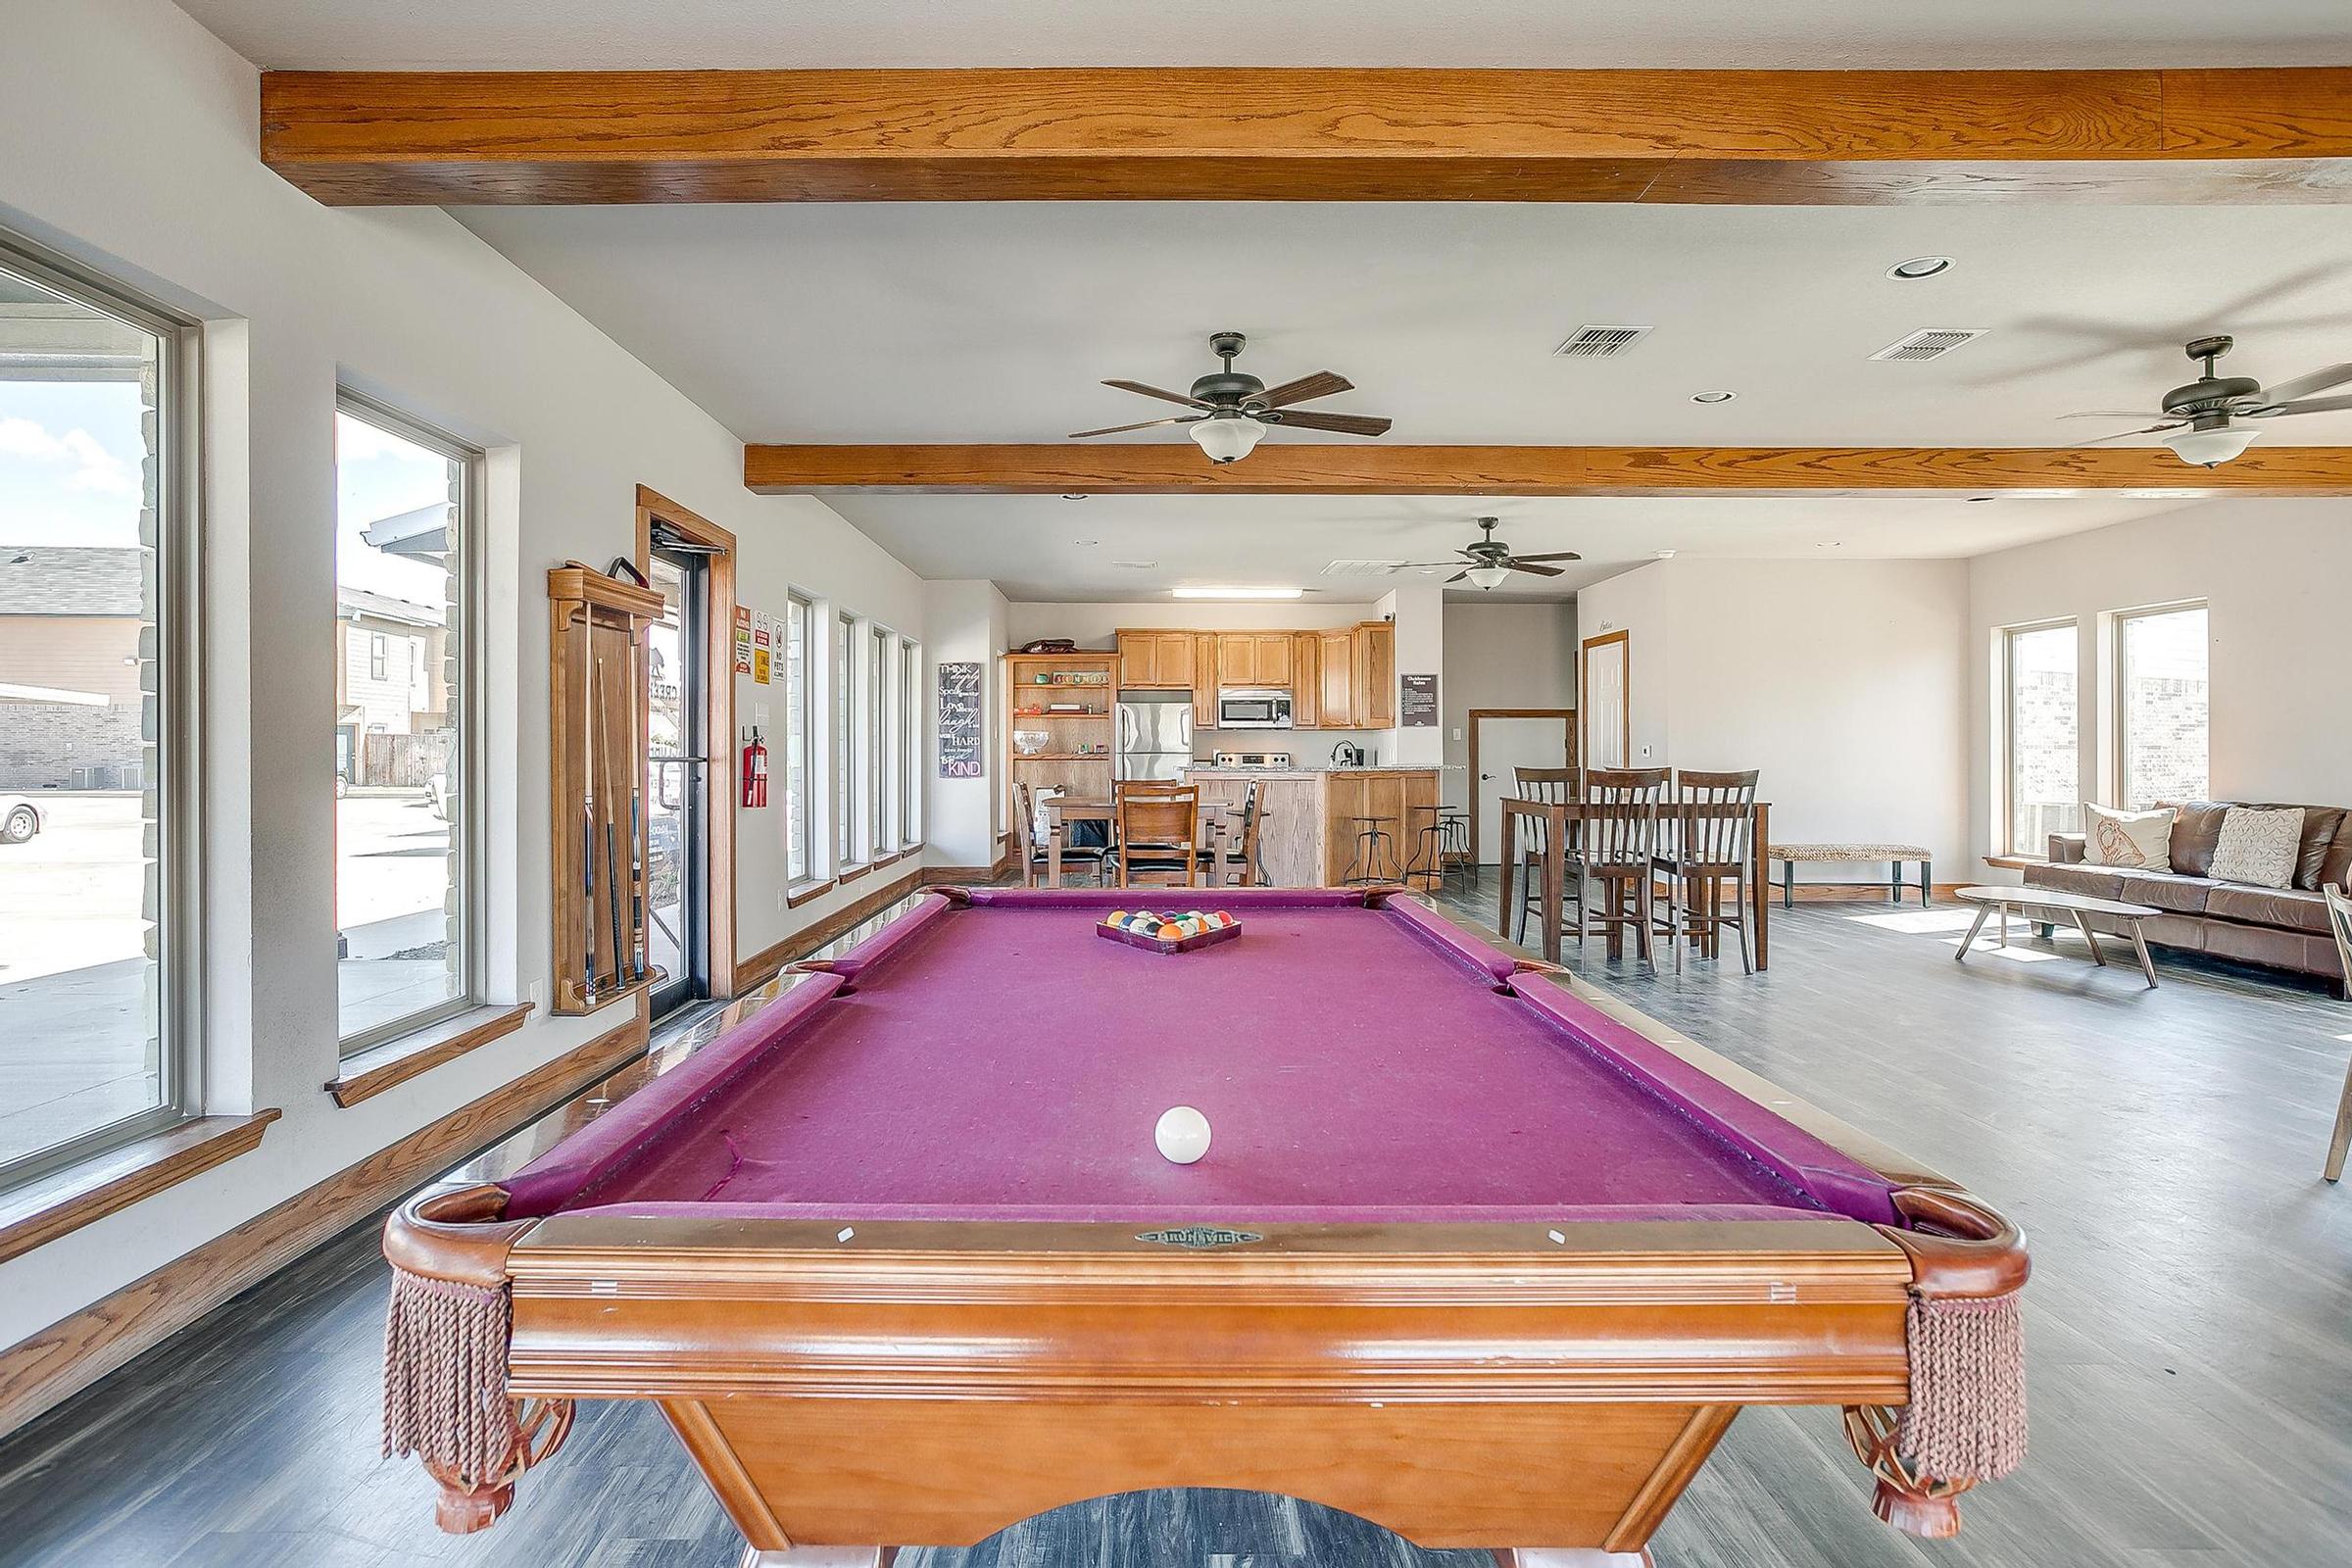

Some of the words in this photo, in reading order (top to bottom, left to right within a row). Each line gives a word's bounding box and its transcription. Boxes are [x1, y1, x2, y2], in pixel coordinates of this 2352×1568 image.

[775, 651, 783, 661] NO
[774, 661, 784, 671] PETS
[940, 664, 972, 673] THINK
[940, 697, 965, 710] Love
[939, 707, 978, 734] laugh
[952, 736, 980, 746] HARD
[948, 760, 981, 776] KIND
